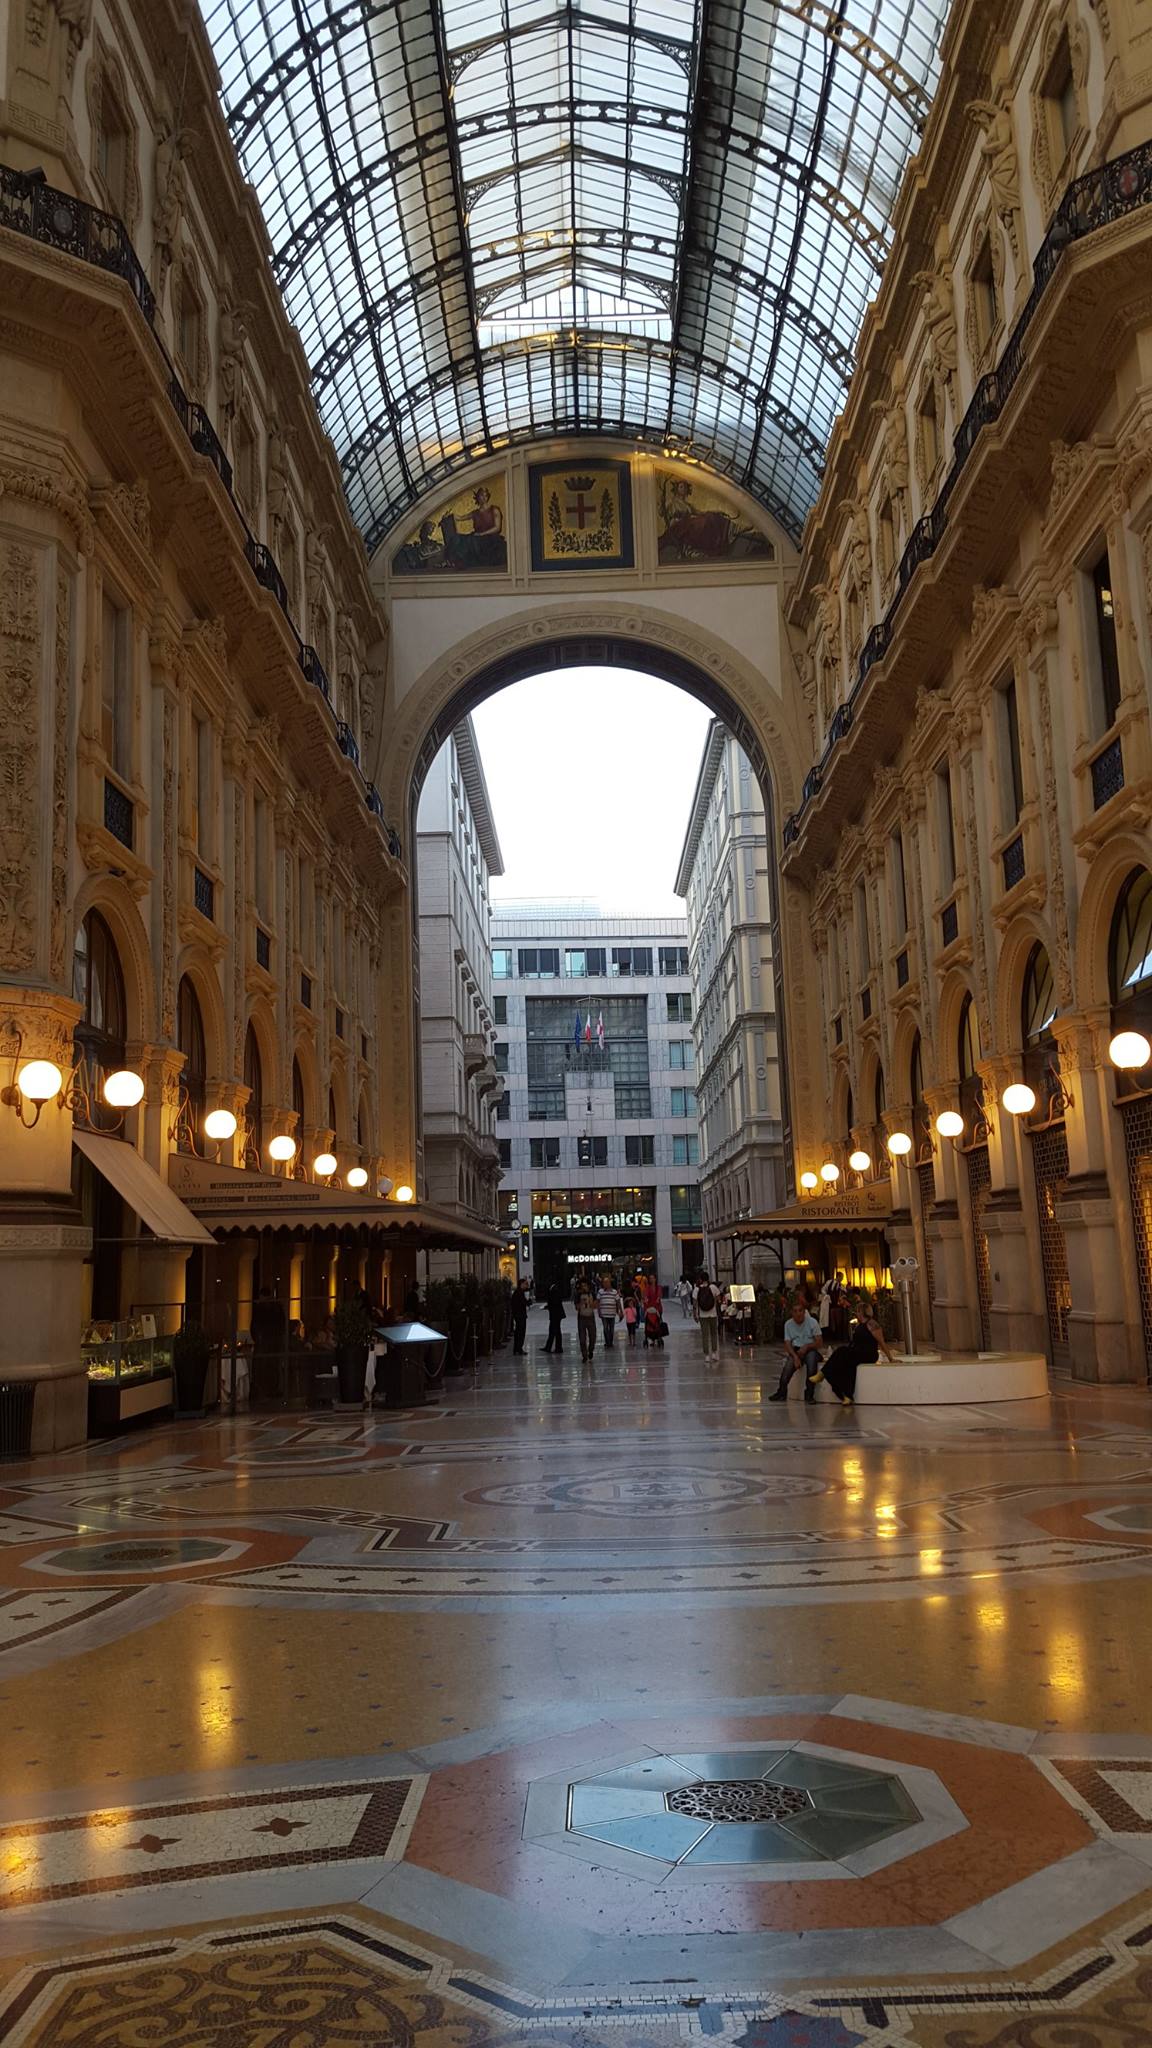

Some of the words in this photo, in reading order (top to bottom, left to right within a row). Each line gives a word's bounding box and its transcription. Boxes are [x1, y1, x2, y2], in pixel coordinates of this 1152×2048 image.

[801, 1207, 861, 1217] RISTORANTE
[533, 1212, 653, 1229] McDonald's
[567, 1253, 612, 1262] McDonald's
